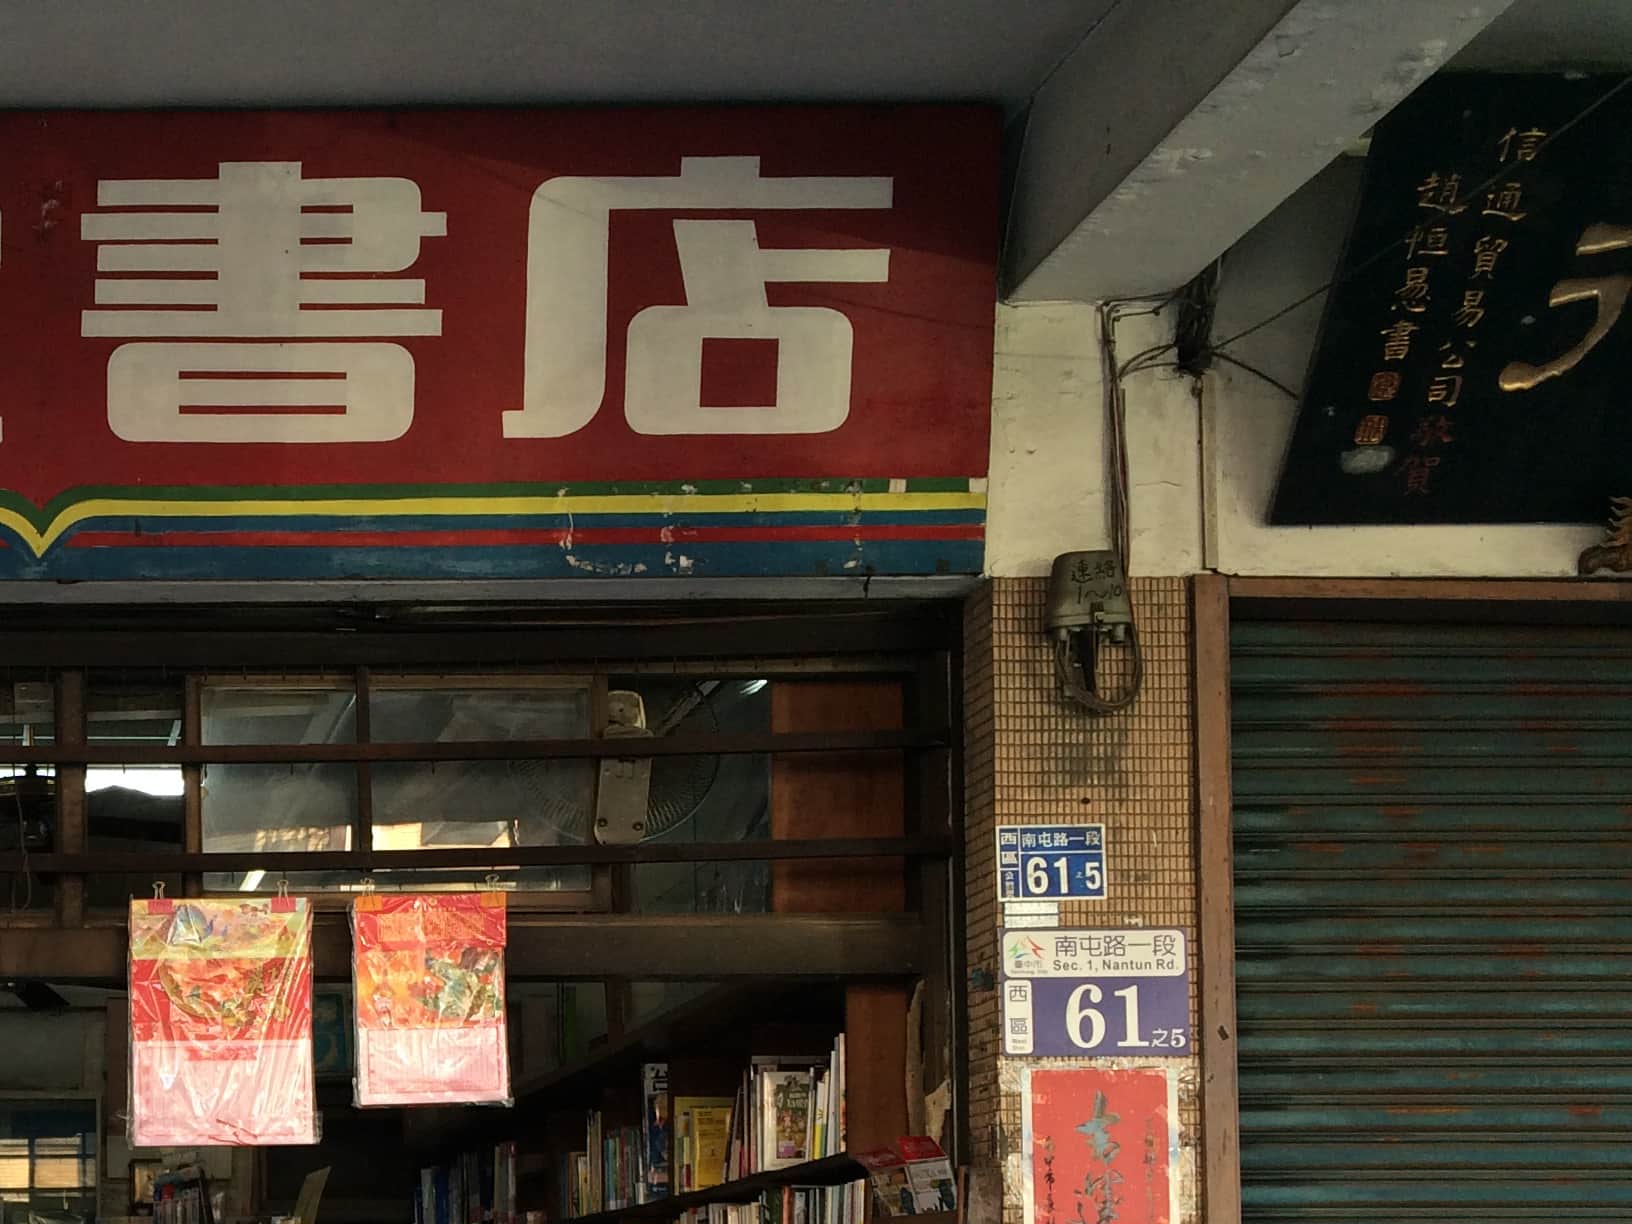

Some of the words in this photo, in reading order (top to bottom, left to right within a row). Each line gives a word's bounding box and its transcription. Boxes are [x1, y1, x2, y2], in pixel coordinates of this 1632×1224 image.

[1000, 832, 1018, 865] 西區
[1021, 831, 1101, 849] 南屯路一段
[1054, 934, 1177, 958] 南屯路一段
[1053, 959, 1082, 971] Sec.
[1102, 959, 1152, 971] Nantun
[1156, 958, 1179, 971] Rd.
[1009, 985, 1028, 1035] 西區
